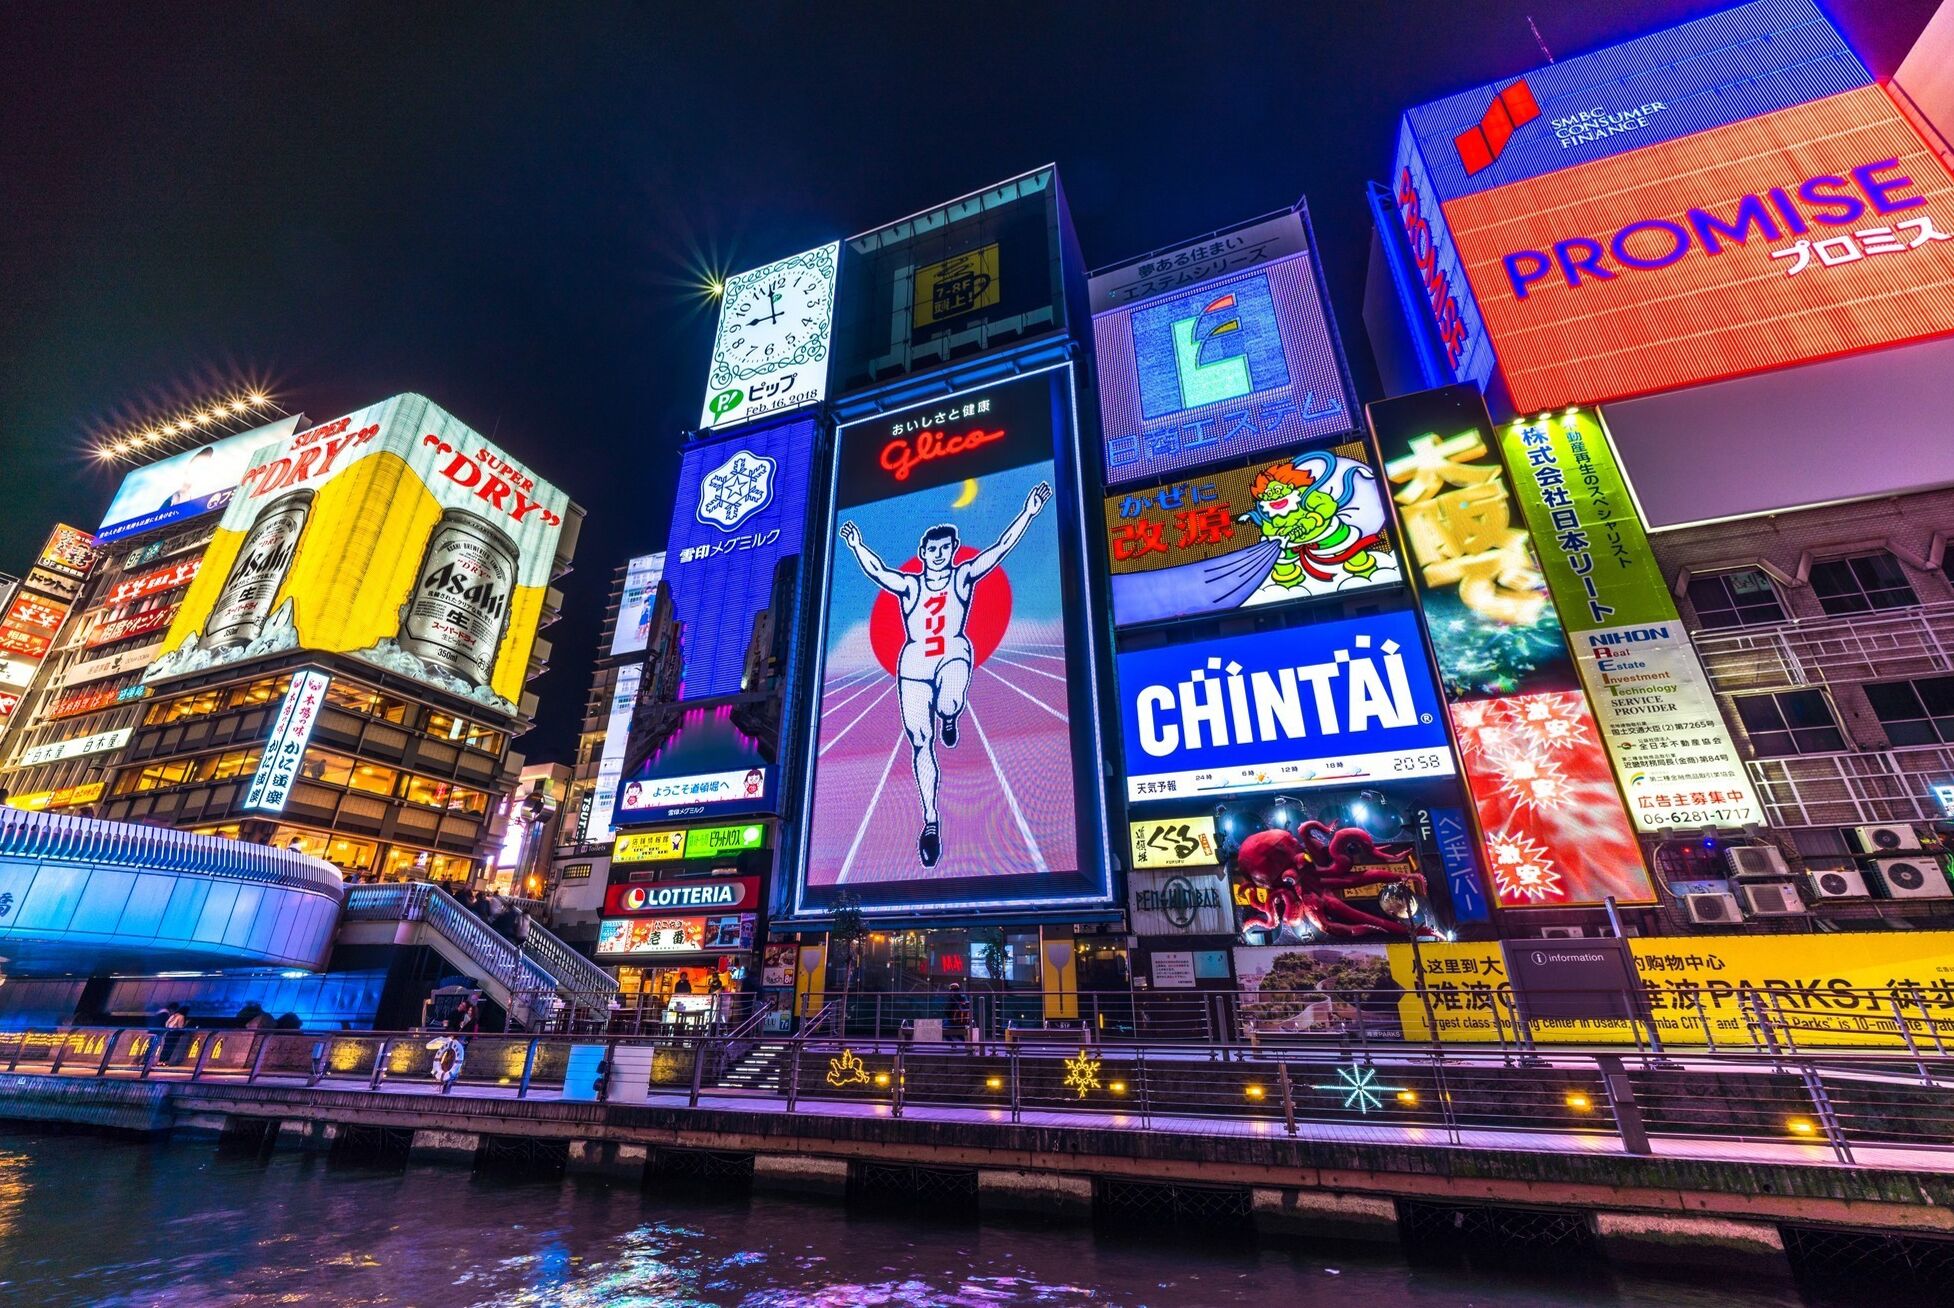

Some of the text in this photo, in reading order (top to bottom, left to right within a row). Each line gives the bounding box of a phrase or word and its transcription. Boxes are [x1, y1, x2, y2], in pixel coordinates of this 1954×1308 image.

[1552, 107, 1605, 130] SMBC
[1556, 102, 1668, 138] CONSUMER
[1562, 117, 1649, 149] FINANCE
[1503, 157, 1927, 300] PROMISE
[1771, 216, 1953, 277] プロミス
[1138, 236, 1244, 279] 夢ある住まい
[1123, 246, 1268, 300] エステムシリーズ
[1401, 167, 1468, 371] PROMISE
[771, 277, 786, 291] 12
[793, 276, 802, 288] 1
[803, 283, 817, 295] 2
[752, 287, 766, 301] 11
[807, 298, 821, 308] 3
[736, 302, 751, 318] 10
[729, 323, 741, 334] 9
[801, 316, 813, 327] 4
[732, 337, 745, 349] 8
[785, 332, 796, 345] 5
[745, 345, 758, 358] 7
[764, 343, 775, 356] 6
[748, 373, 798, 401] ピップ
[745, 403, 769, 416] Feb.
[788, 389, 818, 404] 2018
[892, 399, 991, 436] おいしさと健康
[290, 418, 352, 452] SUPER
[880, 429, 1005, 482] Glico
[476, 448, 535, 493] SUPER
[1119, 482, 1219, 519] かぜに
[1563, 420, 1632, 568] 不動産再生のスペシャリスト
[1111, 502, 1235, 562] 改源
[1521, 426, 1615, 625] 株式会社日本リート
[679, 528, 781, 564] 雪印メグミルク
[228, 540, 294, 588] Asahi
[237, 586, 257, 603] 生
[425, 562, 505, 620] Asahi
[446, 608, 470, 631] 生
[924, 591, 948, 658] グリコ
[432, 620, 477, 645] スーパードライ
[1589, 626, 1670, 647] NIHON
[437, 648, 459, 663] 350ml
[1593, 648, 1631, 660] Real
[1598, 660, 1646, 672] Estate
[1602, 671, 1671, 685] Investment
[1604, 683, 1678, 697] Technology
[1611, 694, 1664, 708] SERVICE
[1614, 703, 1678, 717] PROVIDER
[83, 733, 119, 753] 白木屋
[265, 693, 315, 806] 本場の味 かに道楽
[1639, 737, 1722, 751] 全日本不動産協会
[1241, 769, 1255, 778] 6時
[1281, 765, 1299, 774] 12時
[1325, 761, 1344, 769] 18時
[1136, 779, 1178, 795] 天気予報
[1195, 773, 1213, 782] 24時
[652, 780, 730, 798] ようこそ道頓堀へ
[1638, 789, 1745, 809] 広告主募集中
[1643, 807, 1750, 825] 06-6281-1717
[1146, 824, 1200, 860] くくる
[1439, 816, 1479, 911] ペンギンバー
[648, 885, 732, 906] LOTTERIA
[1549, 952, 1604, 963] information
[1422, 1016, 1460, 1030] Lrgest
[1463, 1016, 1491, 1029] class
[1717, 1017, 1739, 1030] and
[1837, 1017, 1850, 1030] is
